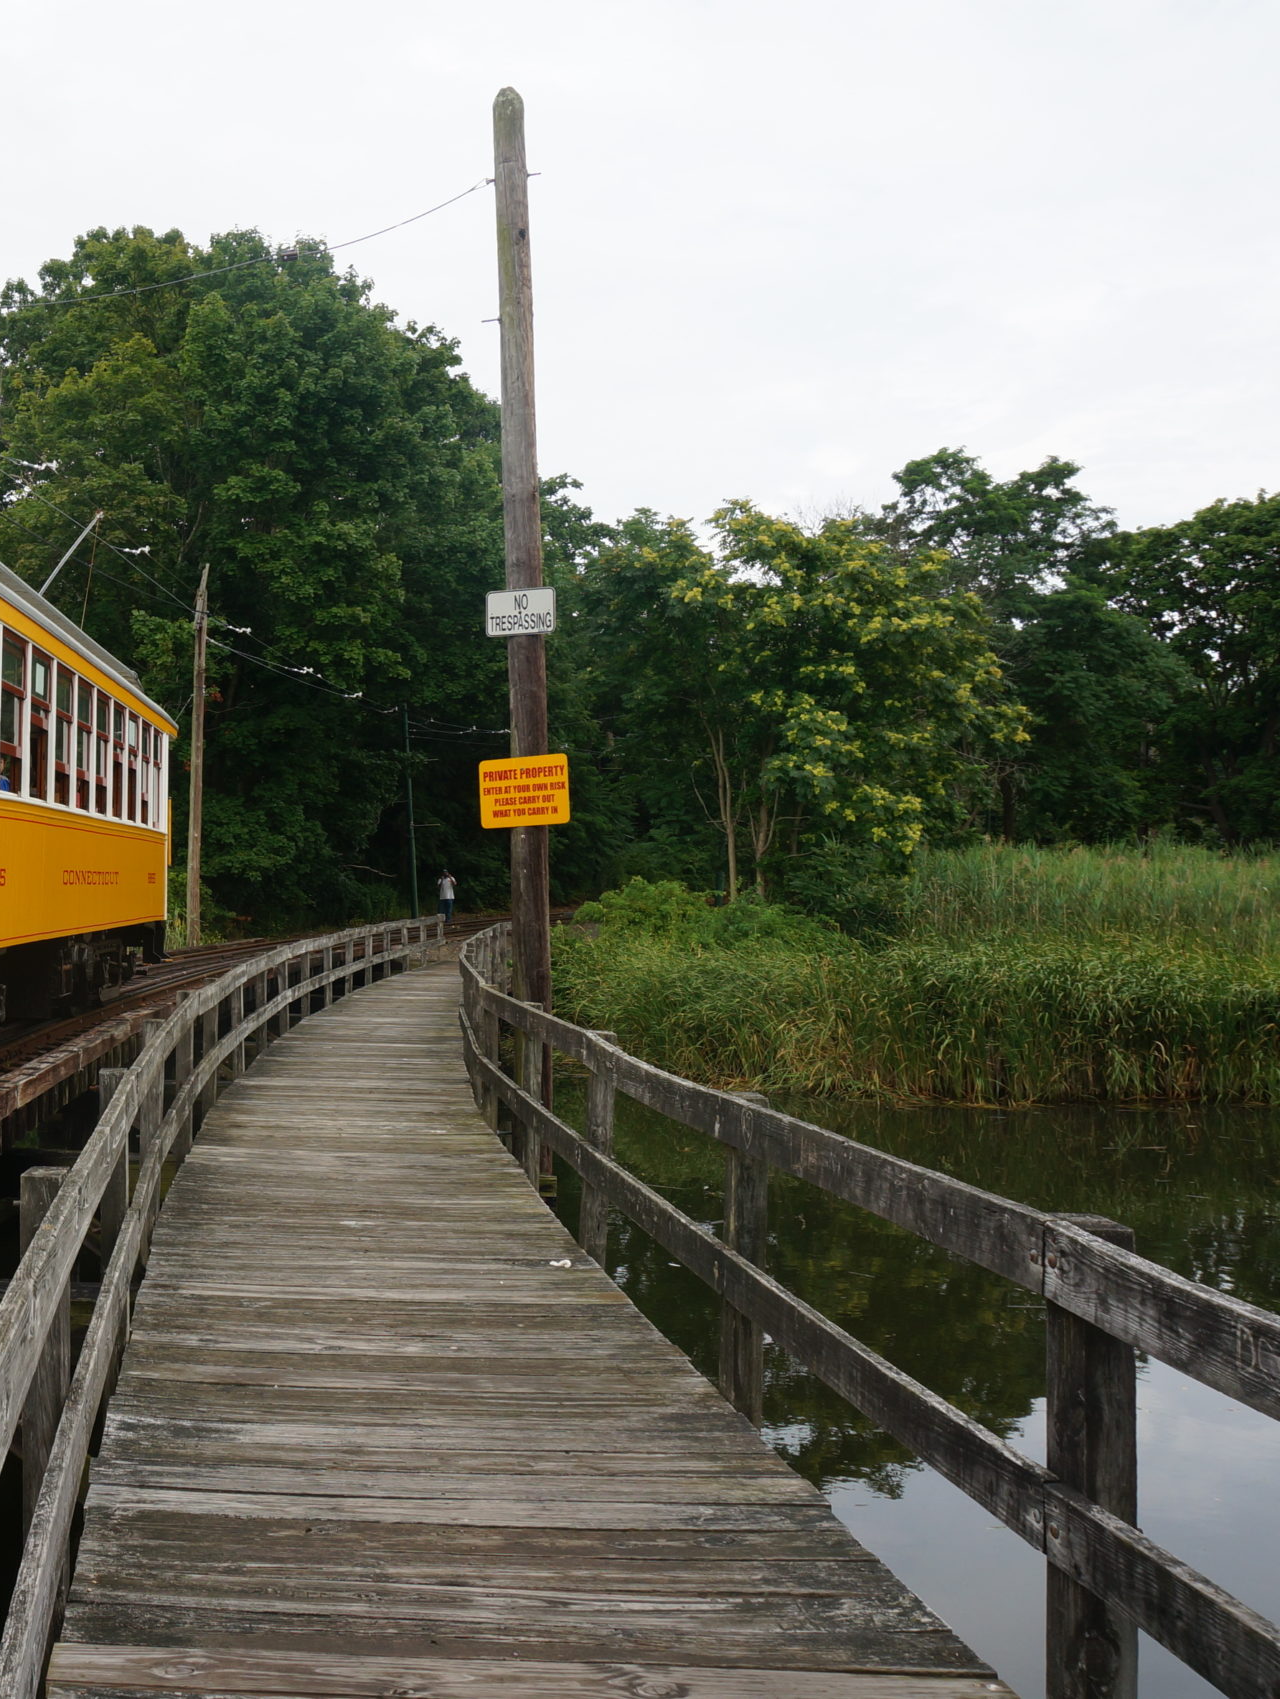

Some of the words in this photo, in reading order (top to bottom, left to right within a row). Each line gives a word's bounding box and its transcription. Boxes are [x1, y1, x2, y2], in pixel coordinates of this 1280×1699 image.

[514, 593, 529, 611] NO
[489, 611, 552, 633] TRESPASSING
[483, 769, 518, 782] PRIVATE
[520, 765, 565, 780] PROPERTY
[483, 786, 503, 796] ENTER
[504, 785, 512, 794] AT
[513, 784, 531, 794] YOUR
[532, 783, 548, 792] OWN
[550, 781, 566, 791] RISK
[494, 797, 517, 807] PLEASE
[519, 795, 540, 805] CARRY
[542, 794, 555, 803] OUT
[492, 809, 511, 818] WHAT
[513, 808, 526, 817] YOU
[527, 807, 549, 816] CARRY
[551, 806, 558, 814] IN
[62, 869, 120, 886] CONNECTICUT
